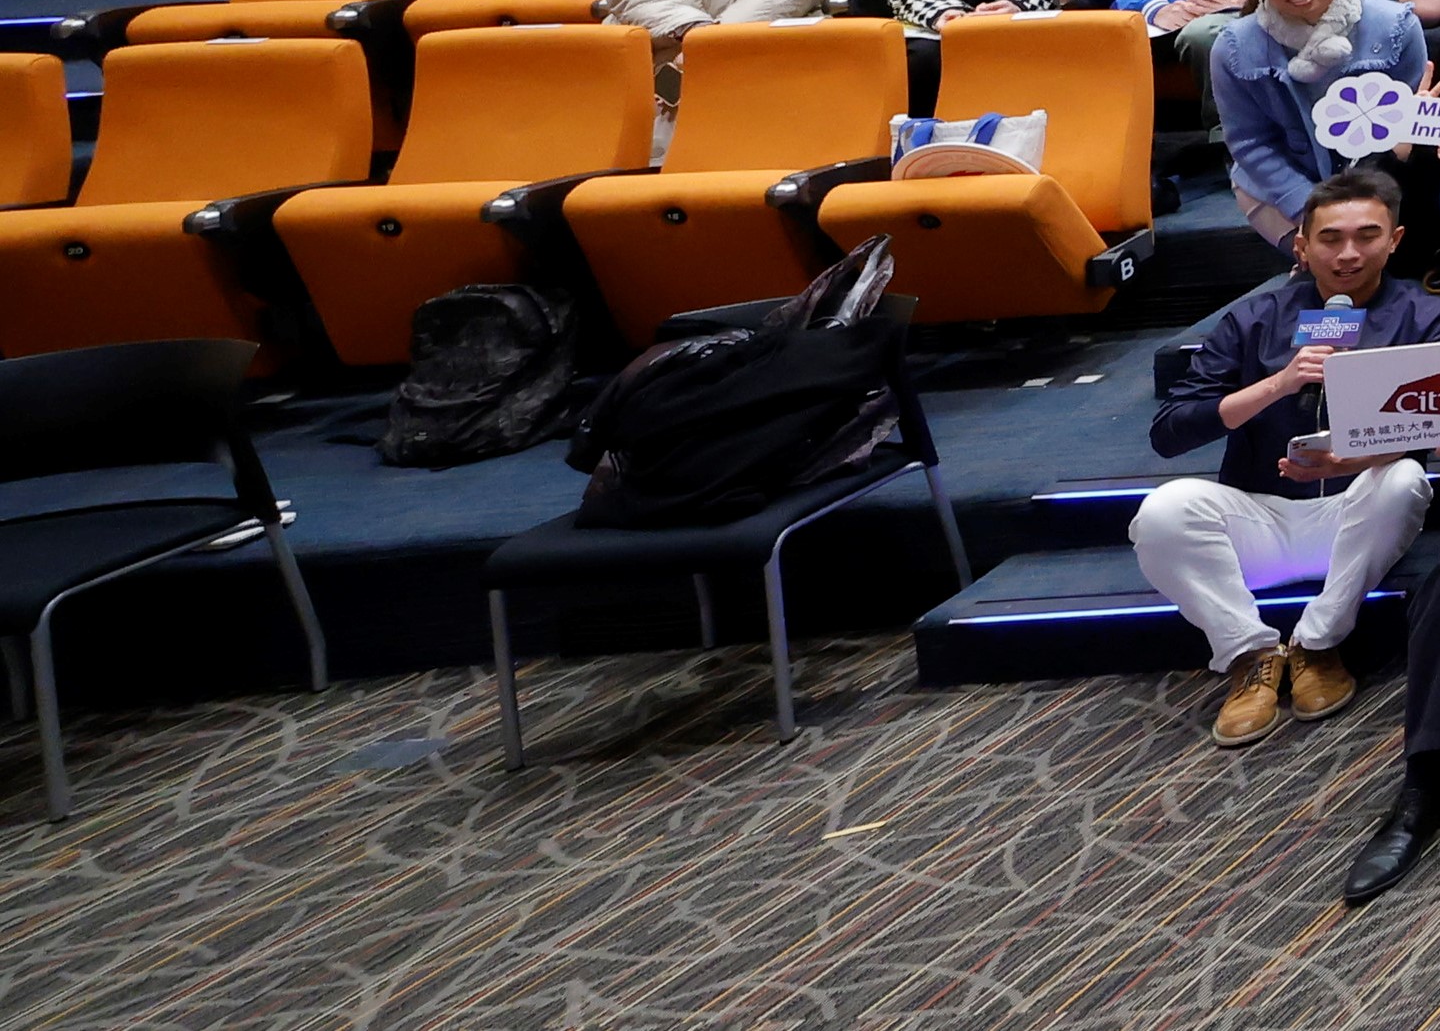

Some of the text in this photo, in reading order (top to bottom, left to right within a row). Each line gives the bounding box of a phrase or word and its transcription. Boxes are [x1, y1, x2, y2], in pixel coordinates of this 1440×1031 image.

[1120, 257, 1135, 281] B
[1348, 419, 1435, 438] 香港城市大學
[1348, 438, 1367, 449] City
[1368, 433, 1412, 447] University
[1412, 431, 1423, 441] of
